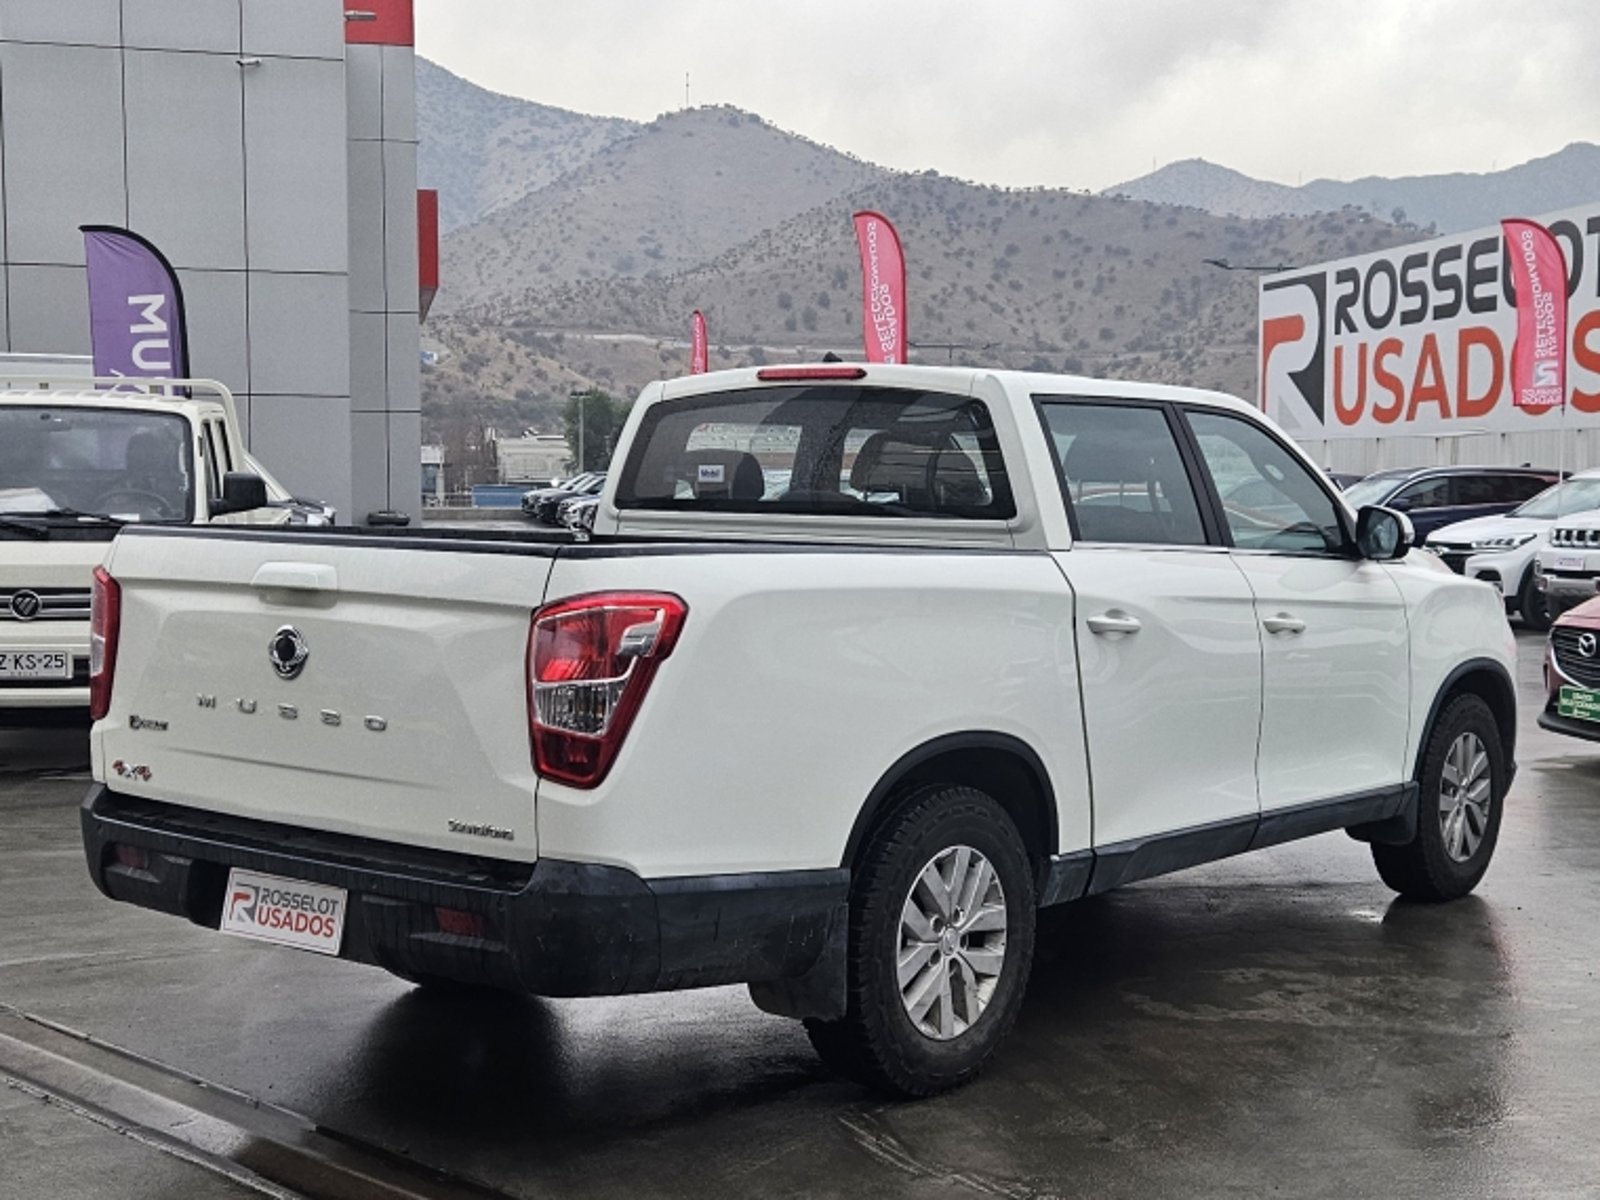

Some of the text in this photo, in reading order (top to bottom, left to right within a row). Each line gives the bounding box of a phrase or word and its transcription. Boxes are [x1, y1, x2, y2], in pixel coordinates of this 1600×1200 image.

[196, 692, 388, 732] MUSSO
[260, 888, 339, 916] ROSSELOT
[257, 905, 336, 938] USADOS
